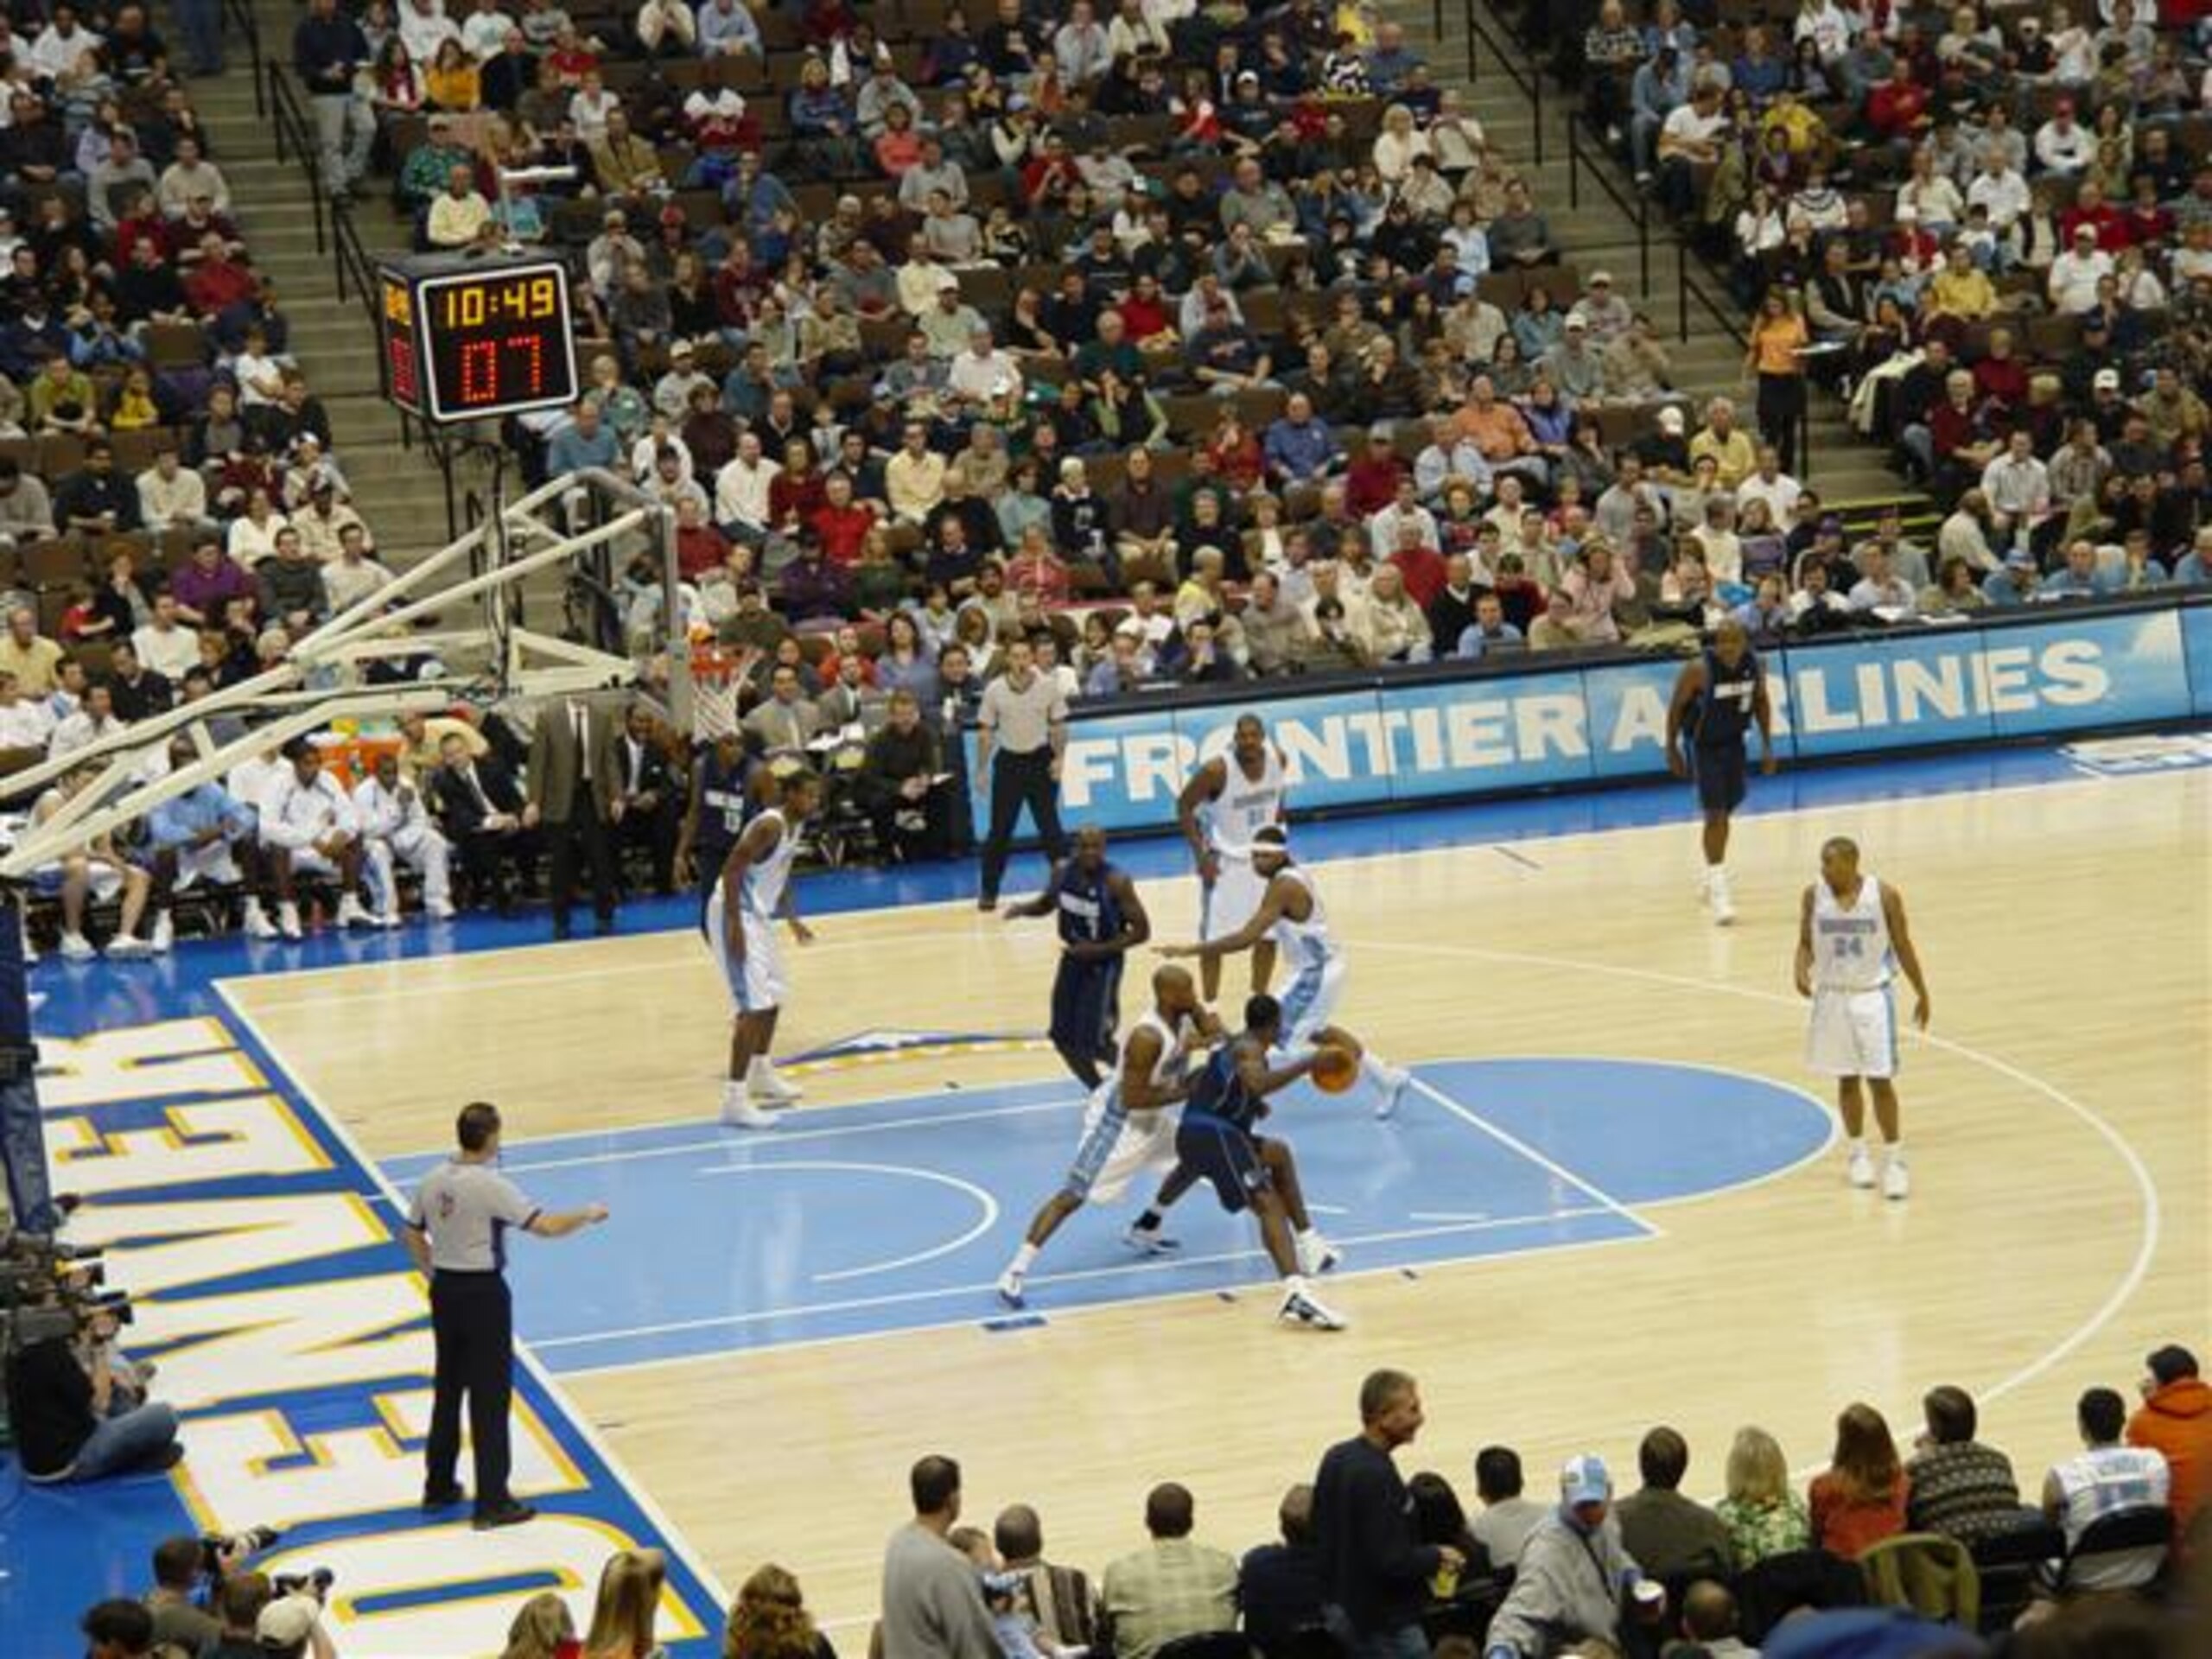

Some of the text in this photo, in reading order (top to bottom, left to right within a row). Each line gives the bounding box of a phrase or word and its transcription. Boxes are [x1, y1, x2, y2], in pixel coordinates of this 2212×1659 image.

[448, 277, 555, 330] 10:49
[462, 333, 542, 402] 07
[1609, 639, 2109, 752] ALINES
